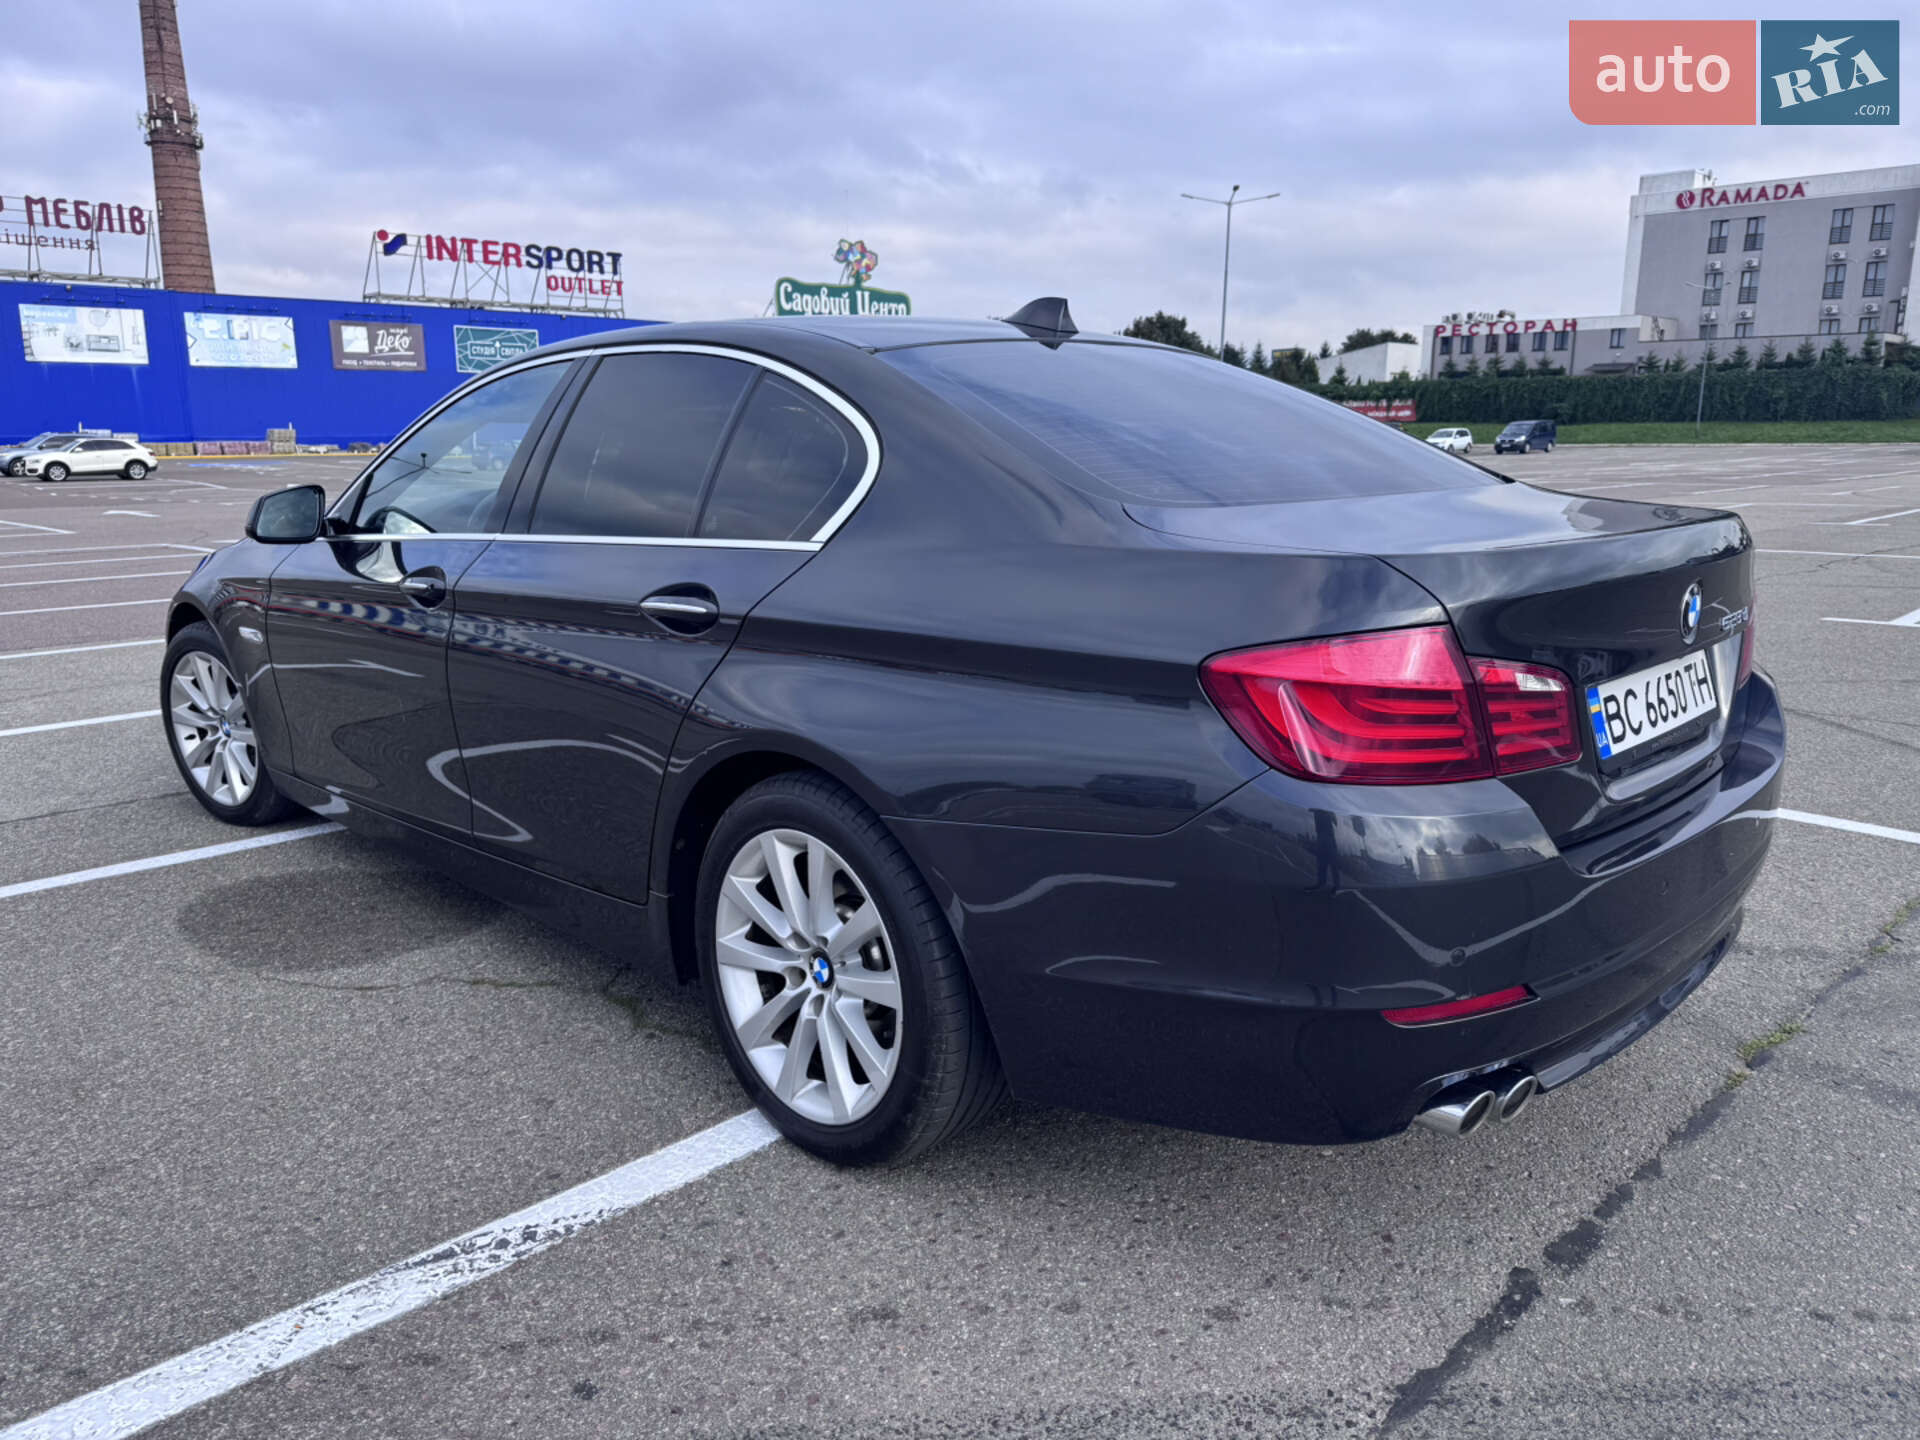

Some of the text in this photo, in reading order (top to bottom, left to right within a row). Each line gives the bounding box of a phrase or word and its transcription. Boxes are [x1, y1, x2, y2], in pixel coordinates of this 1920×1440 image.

[1700, 181, 1806, 208] RAMADA
[24, 195, 147, 235] МЕБЛІВ
[425, 234, 622, 275] INTERSPORT
[546, 275, 624, 297] OUTLET
[779, 281, 850, 316] Садовий
[1435, 318, 1578, 337] РЕСТОРАН
[1603, 688, 1643, 745] BC
[1645, 669, 1688, 729] 6650
[1684, 659, 1713, 707] TH
